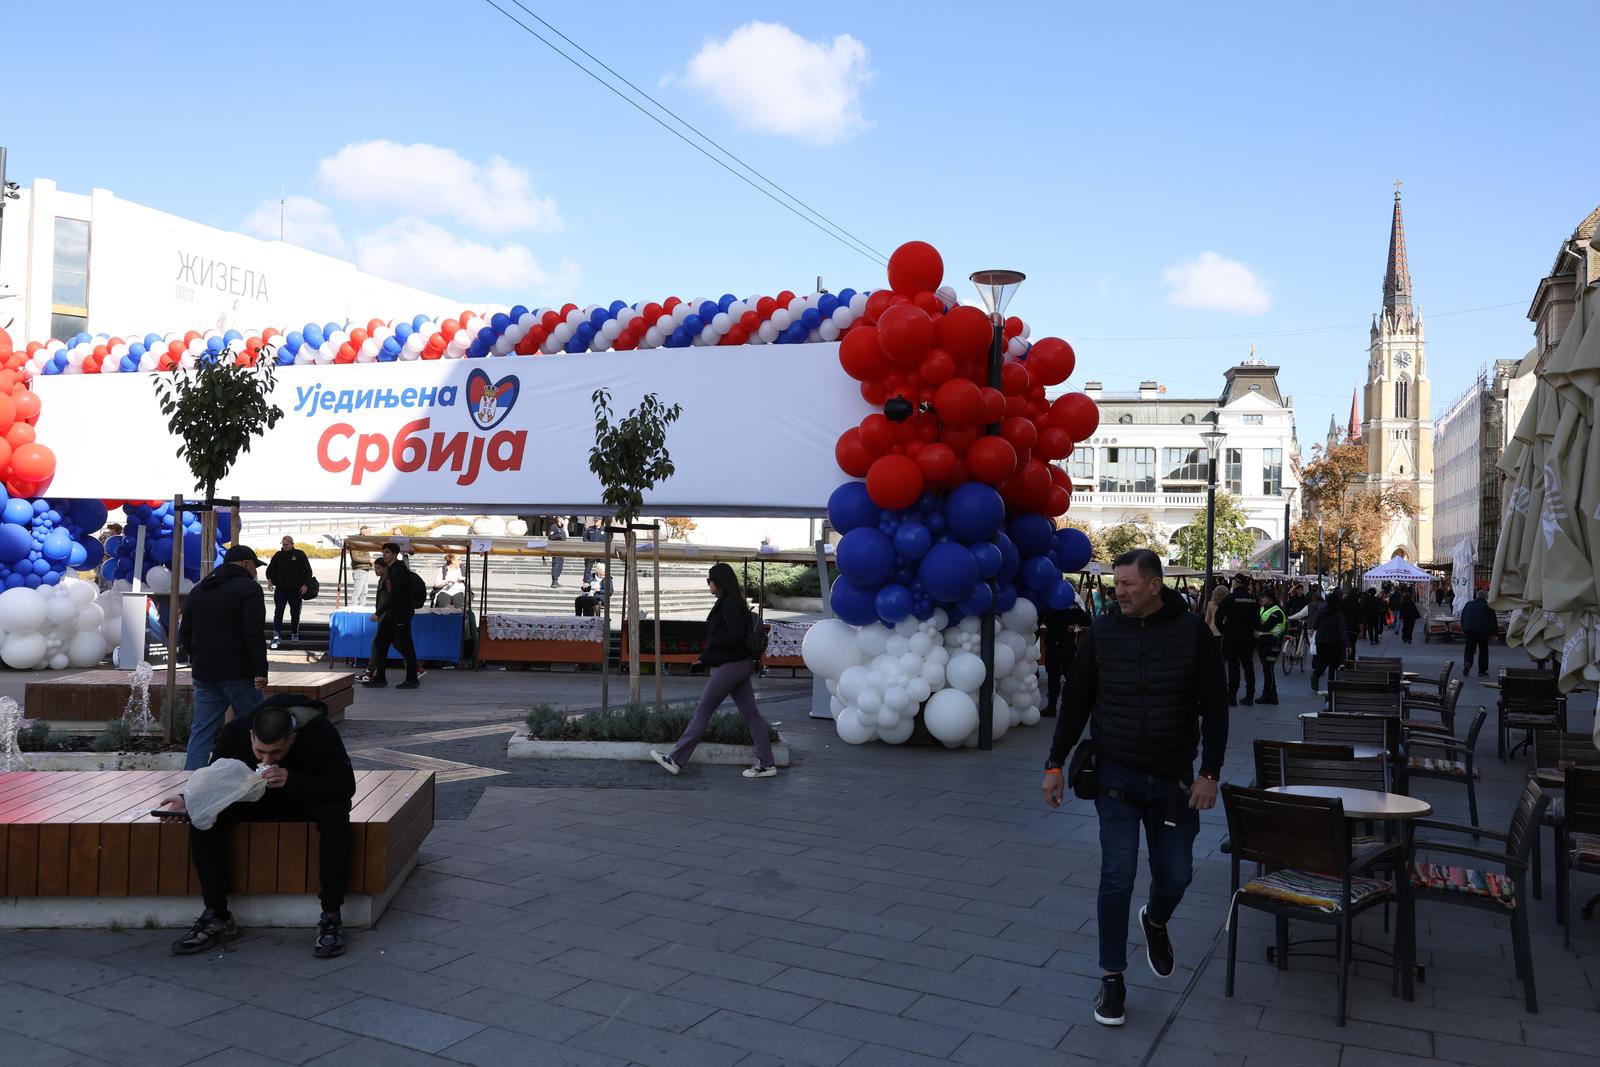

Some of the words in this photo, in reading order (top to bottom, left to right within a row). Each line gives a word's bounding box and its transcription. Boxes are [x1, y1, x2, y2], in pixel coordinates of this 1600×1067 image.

[175, 250, 269, 303] ЖИЗЕЛА
[293, 382, 458, 418] Уједињена
[316, 416, 528, 487] Србија
[479, 543, 485, 551] 2
